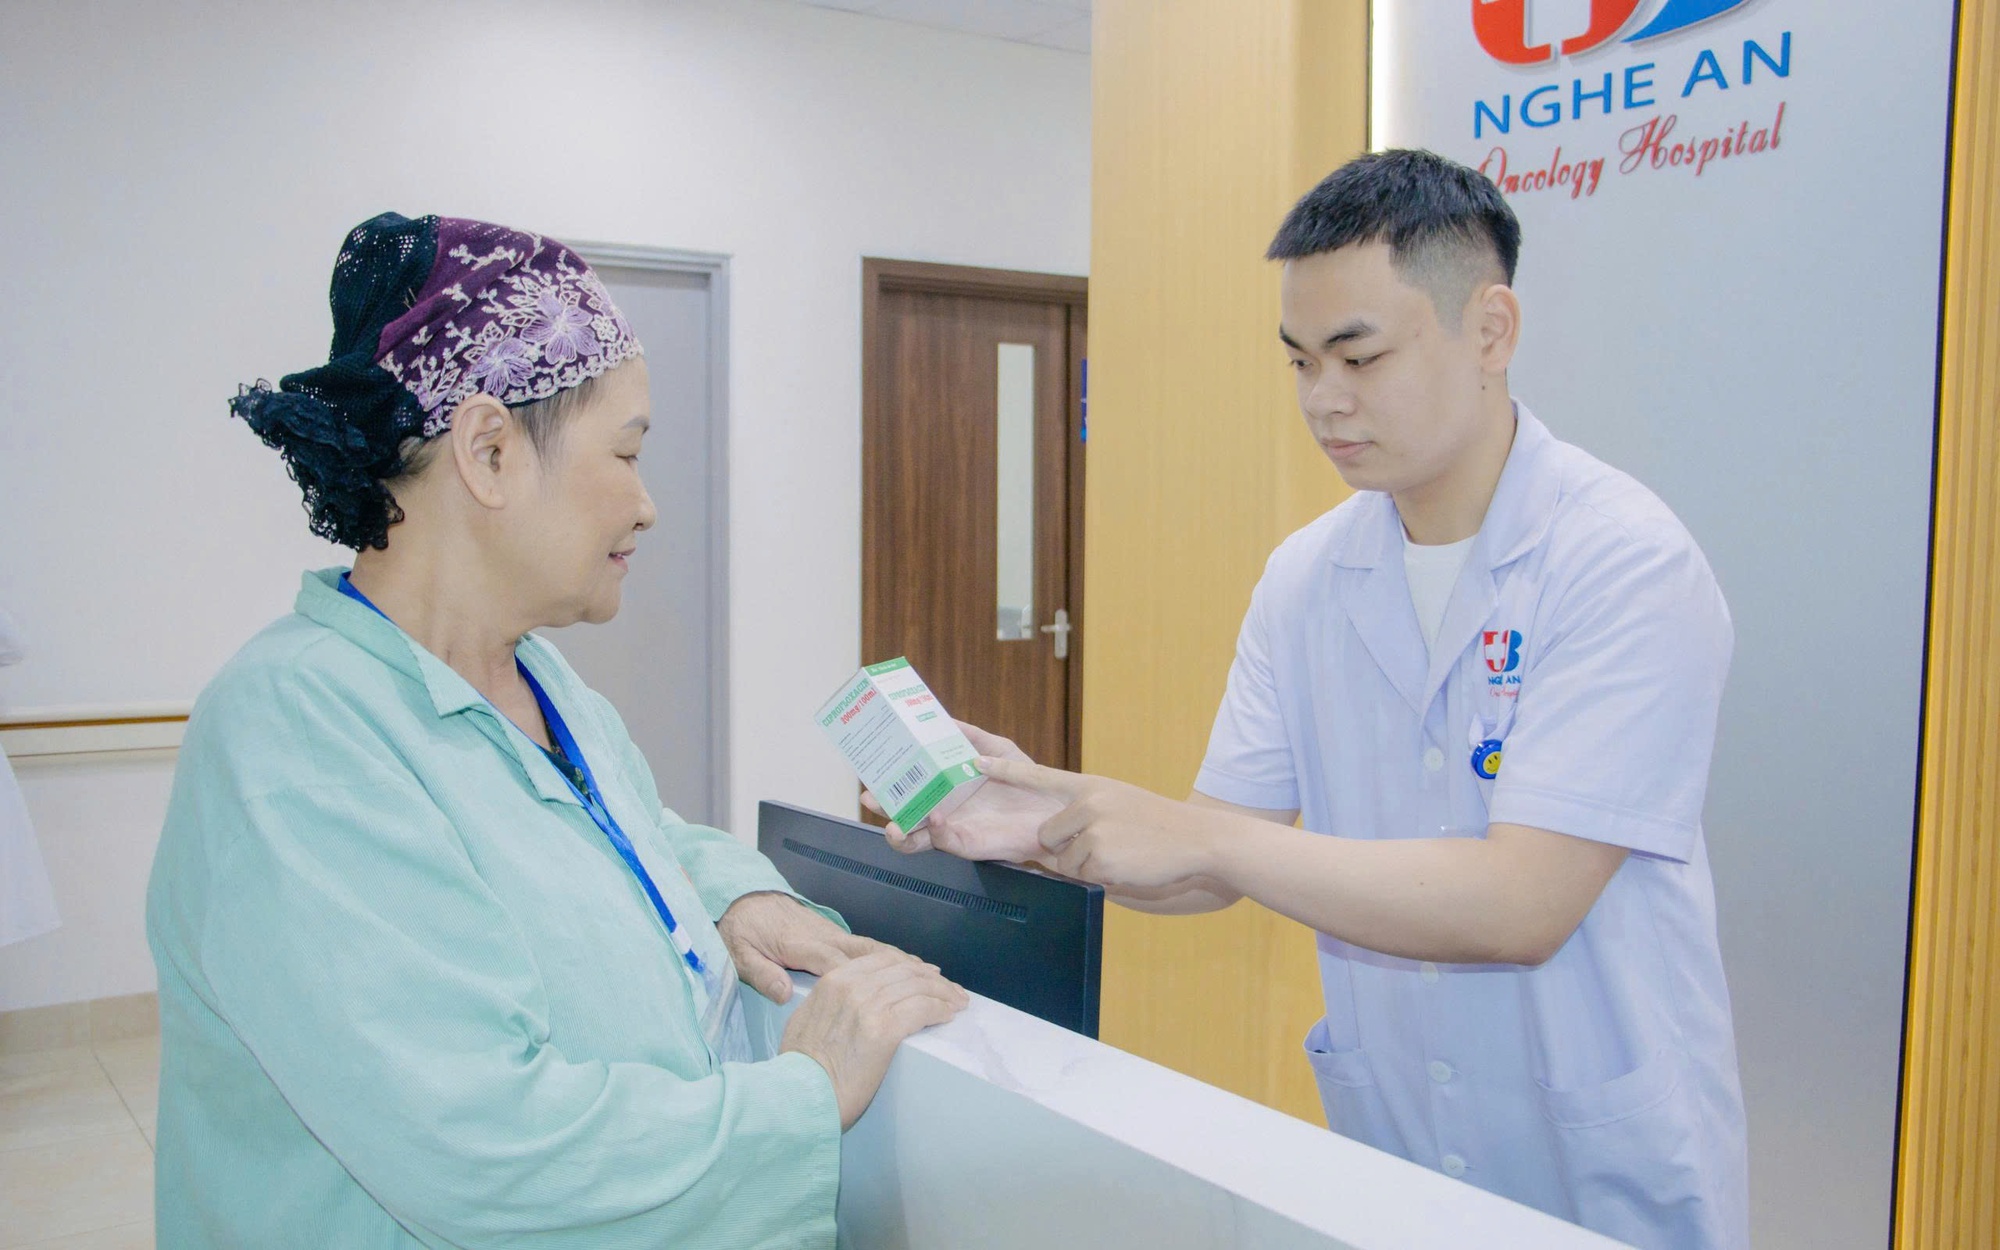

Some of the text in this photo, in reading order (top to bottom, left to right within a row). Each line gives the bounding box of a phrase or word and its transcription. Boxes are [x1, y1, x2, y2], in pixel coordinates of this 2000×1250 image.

[1473, 62, 1656, 139] NGHE
[1680, 31, 1792, 98] AN
[1478, 101, 1786, 200] Oncology Hospital
